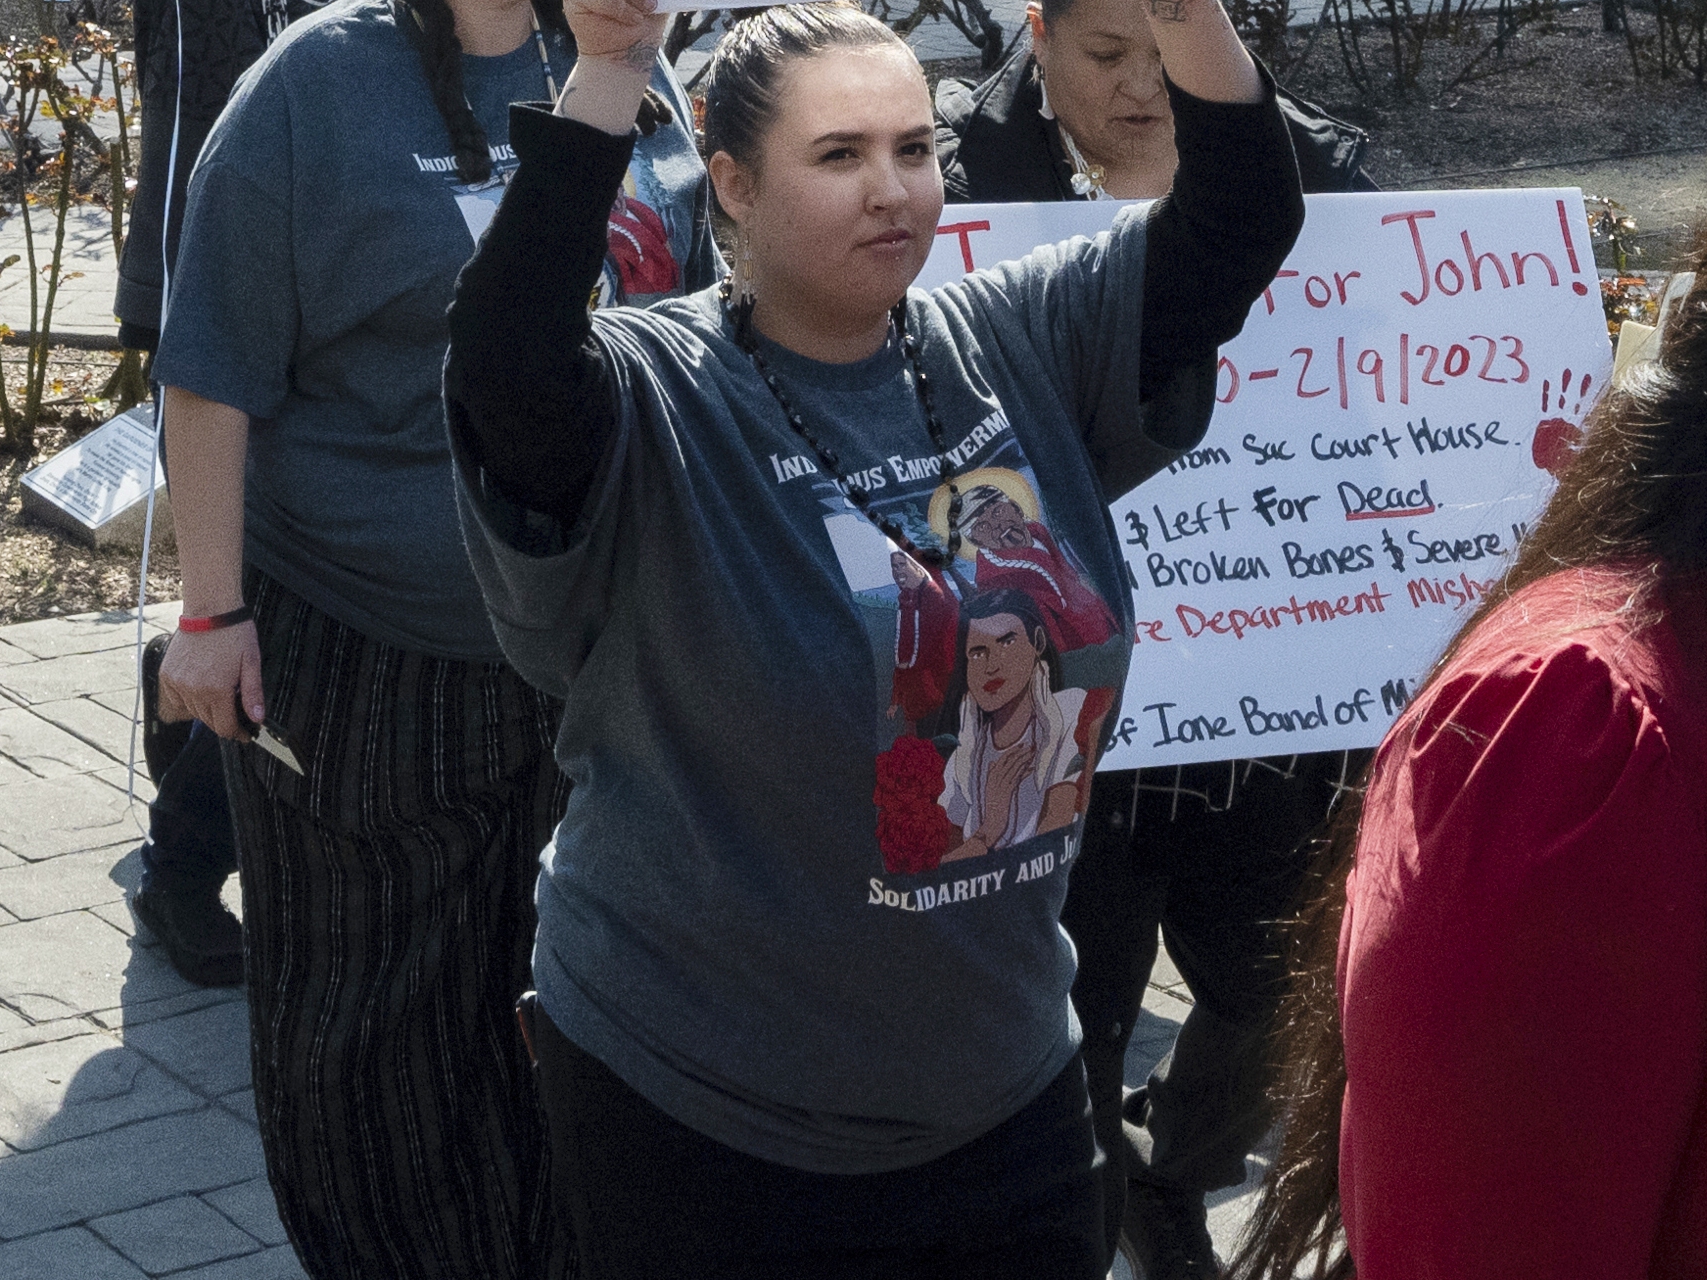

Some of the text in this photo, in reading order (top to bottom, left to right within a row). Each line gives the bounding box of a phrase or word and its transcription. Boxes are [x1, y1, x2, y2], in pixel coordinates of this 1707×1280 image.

[1381, 199, 1587, 306] John!
[887, 409, 1010, 483] EMPOWERM
[1167, 416, 1521, 475] rom Sac Court House.
[1153, 497, 1239, 543] Left
[1252, 486, 1321, 527] For
[1337, 479, 1444, 516] Dead.
[1147, 551, 1271, 588] Broken
[1282, 542, 1374, 579] Bones
[1407, 529, 1507, 564] Severe
[1175, 582, 1392, 640] Department
[1239, 694, 1327, 736] Band
[1334, 688, 1375, 724] of
[868, 869, 1006, 912] SOLIDARITY
[1015, 851, 1055, 884] AND
